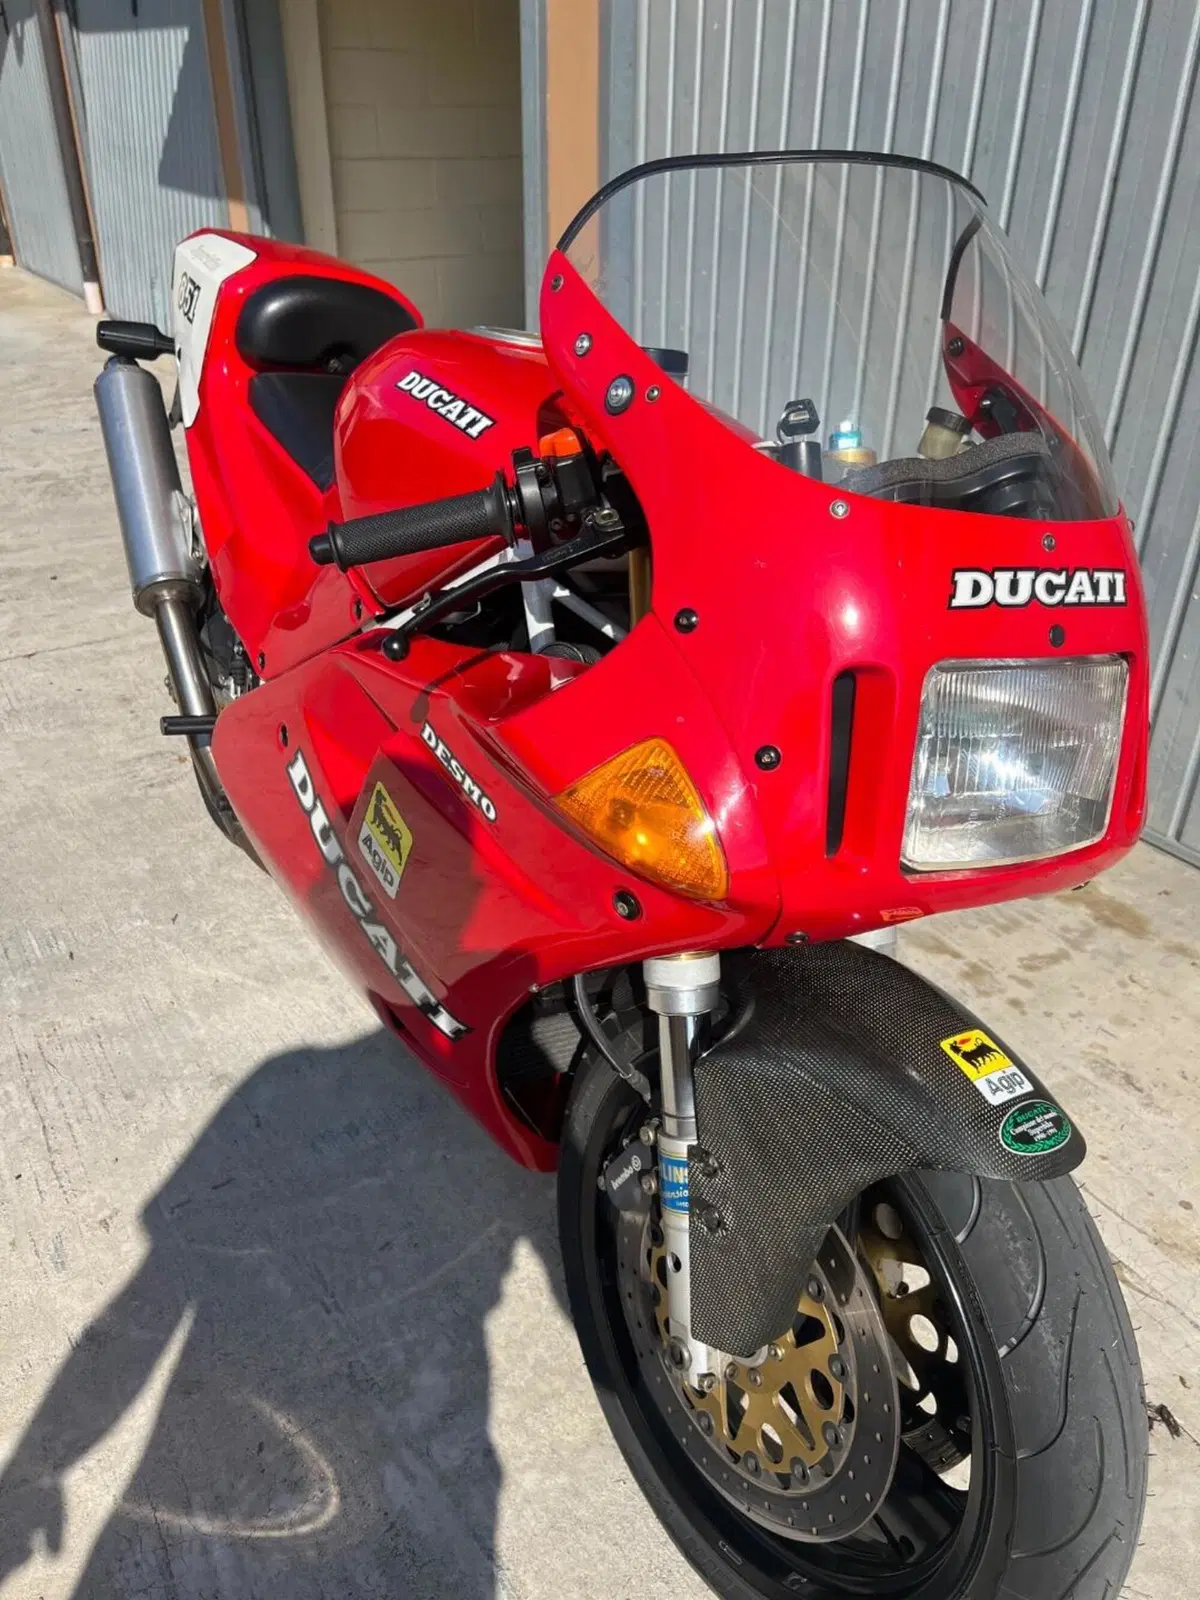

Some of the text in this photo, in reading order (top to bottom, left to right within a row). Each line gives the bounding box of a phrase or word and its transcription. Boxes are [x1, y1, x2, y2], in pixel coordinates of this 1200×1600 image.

[394, 370, 496, 440] DUCATI
[949, 568, 1127, 608] DUCATI
[420, 721, 497, 821] DESMO
[362, 833, 394, 887] Agip
[286, 748, 471, 1041] DUCATI
[985, 1070, 1025, 1096] Agip
[610, 1165, 634, 1190] brembo
